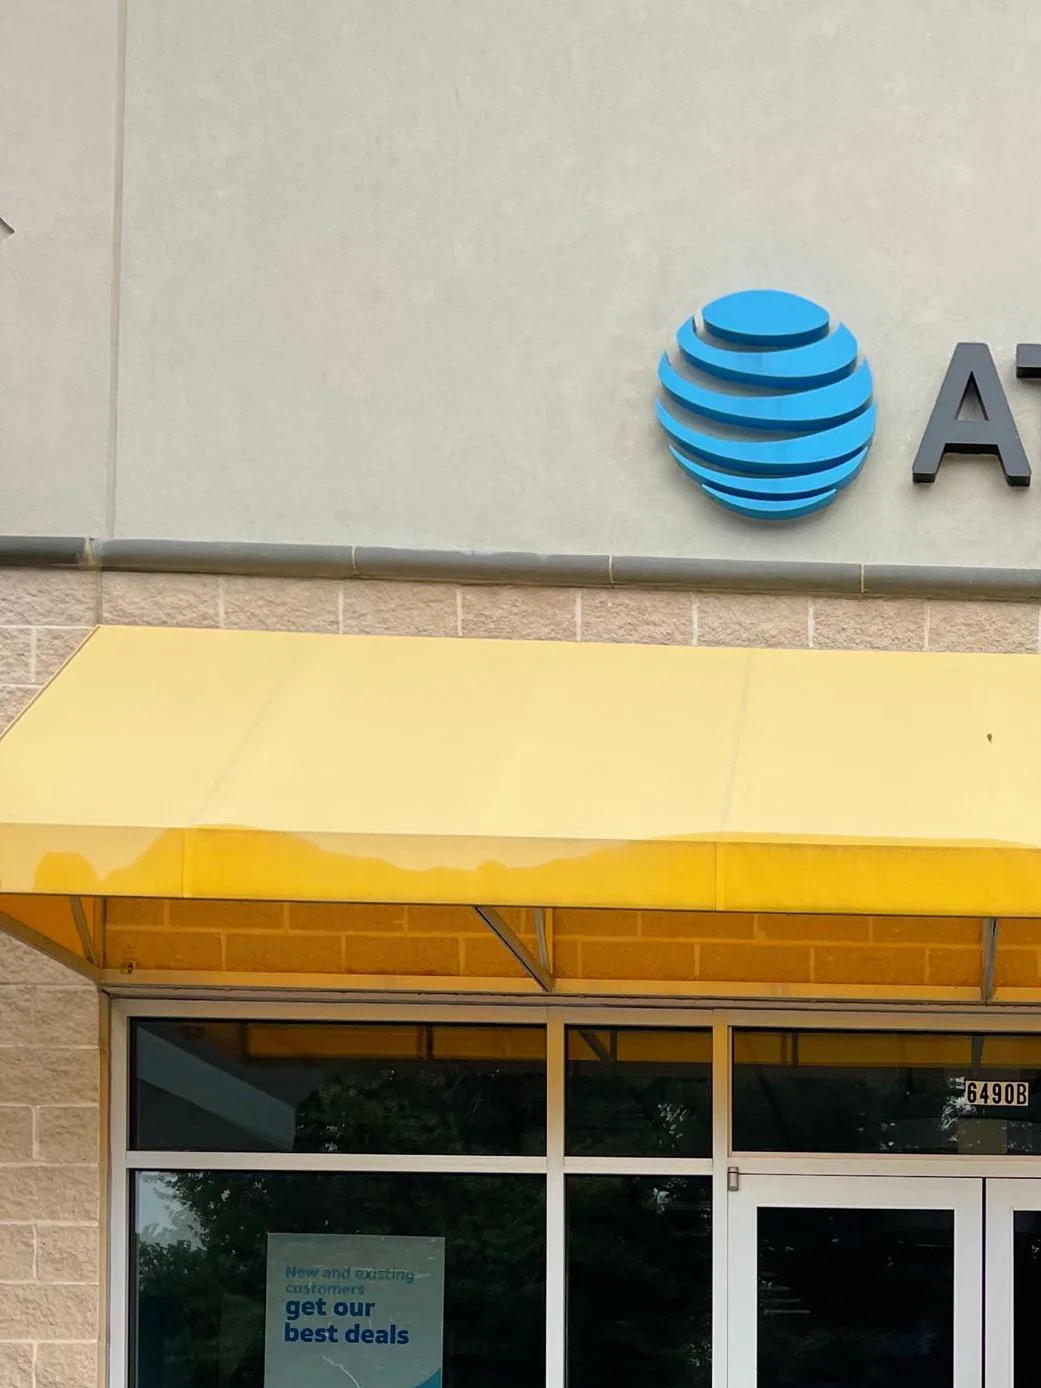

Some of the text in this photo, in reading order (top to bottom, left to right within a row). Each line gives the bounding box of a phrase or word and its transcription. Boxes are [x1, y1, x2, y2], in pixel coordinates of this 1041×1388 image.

[967, 1082, 1027, 1105] 6490B
[286, 1266, 414, 1284] New and existing
[286, 1283, 365, 1295] customers
[286, 1299, 375, 1320] get our
[284, 1323, 409, 1344] best deals
